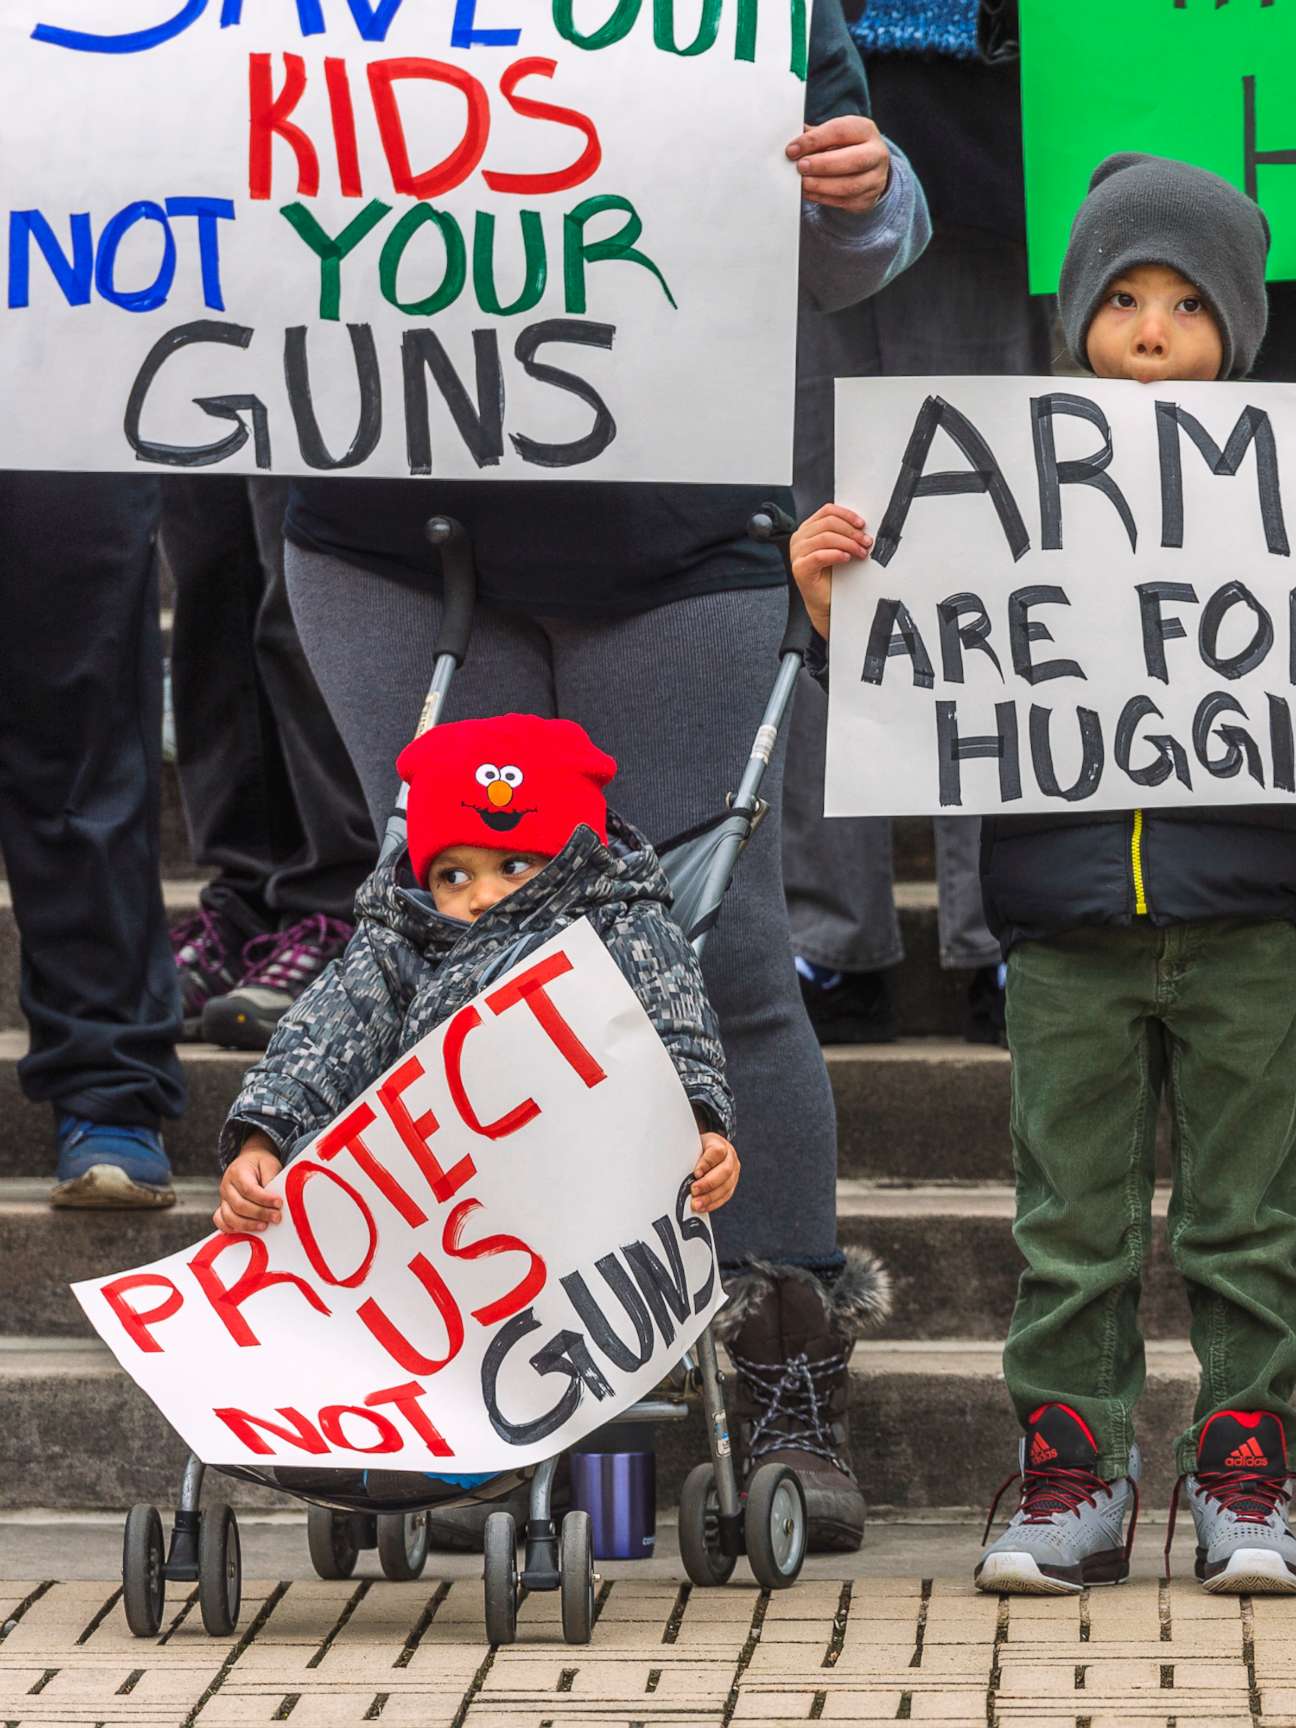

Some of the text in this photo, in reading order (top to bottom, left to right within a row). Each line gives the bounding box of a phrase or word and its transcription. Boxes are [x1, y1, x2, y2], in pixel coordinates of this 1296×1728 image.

[249, 52, 603, 200] KIDS
[8, 193, 678, 321] NOT YOUR
[123, 318, 617, 475] GUNS
[860, 584, 1088, 689] ARE
[99, 949, 608, 1353] PROTECT
[212, 1172, 715, 1457] NOT GUNS
[356, 1197, 548, 1376] US
[1225, 1456, 1268, 1467] adidas
